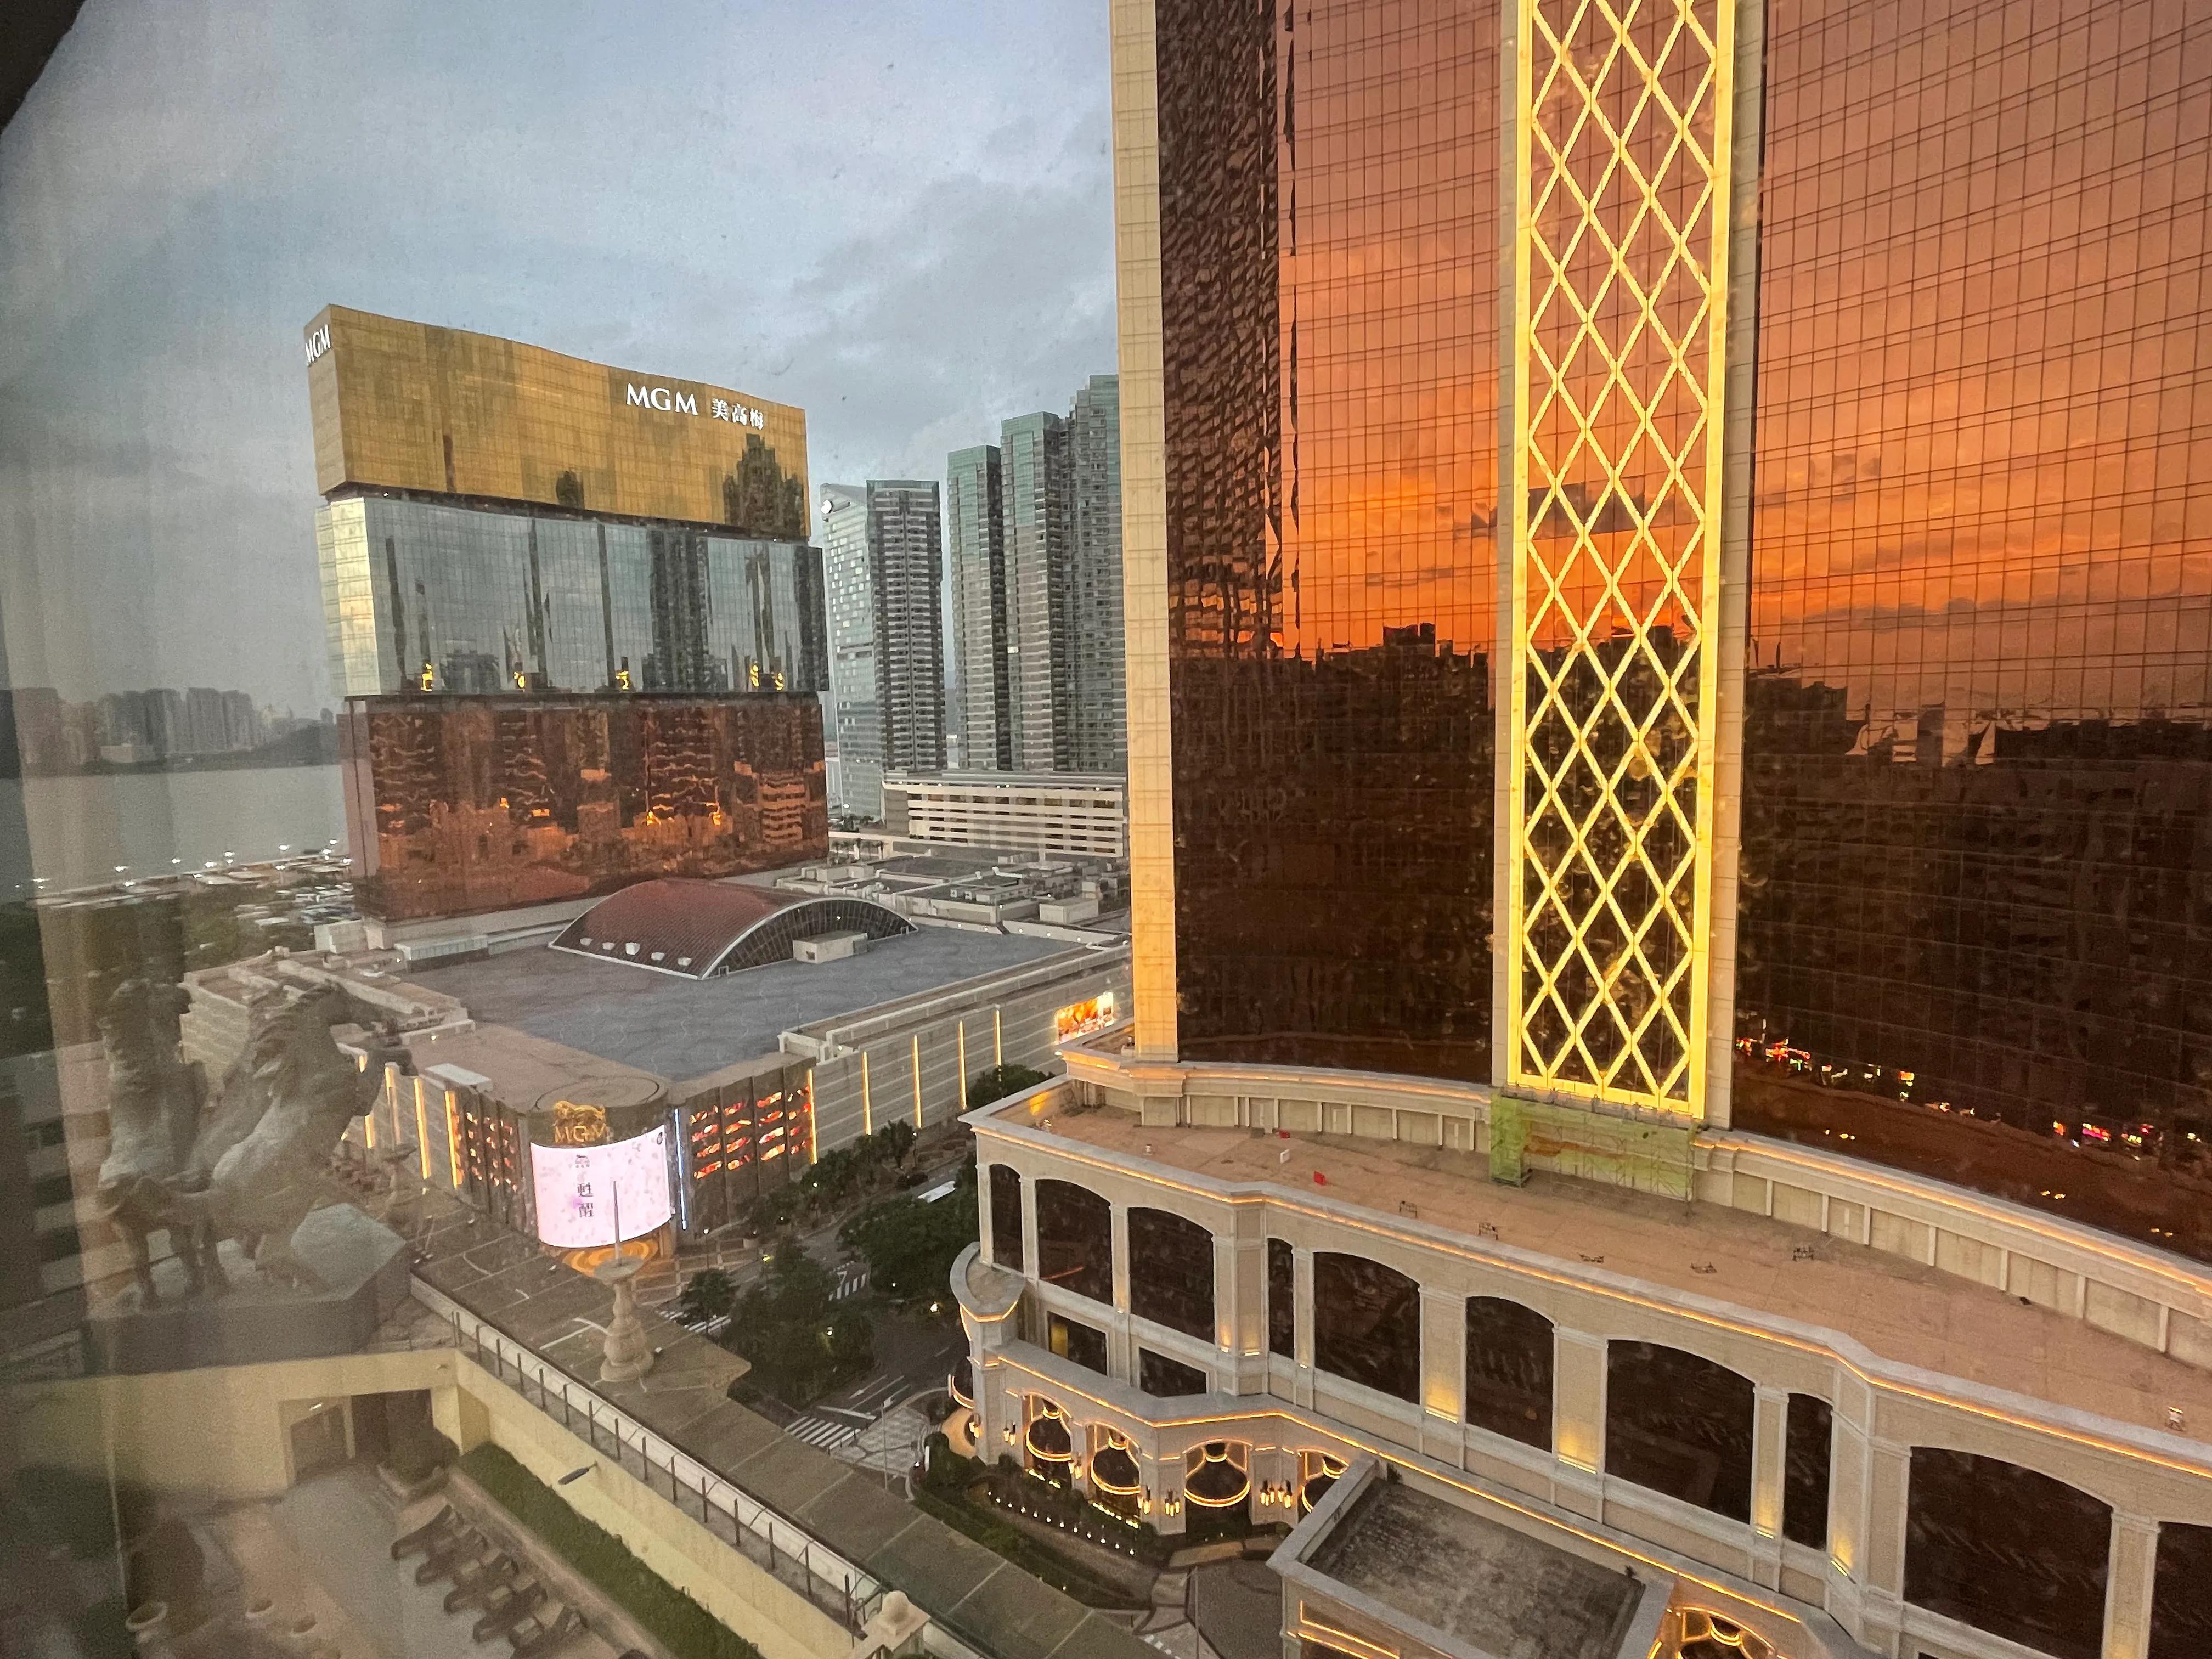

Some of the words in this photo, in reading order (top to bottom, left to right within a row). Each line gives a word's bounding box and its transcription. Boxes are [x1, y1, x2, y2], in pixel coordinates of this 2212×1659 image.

[626, 382, 698, 416] MGM
[712, 398, 764, 430] 美高梅
